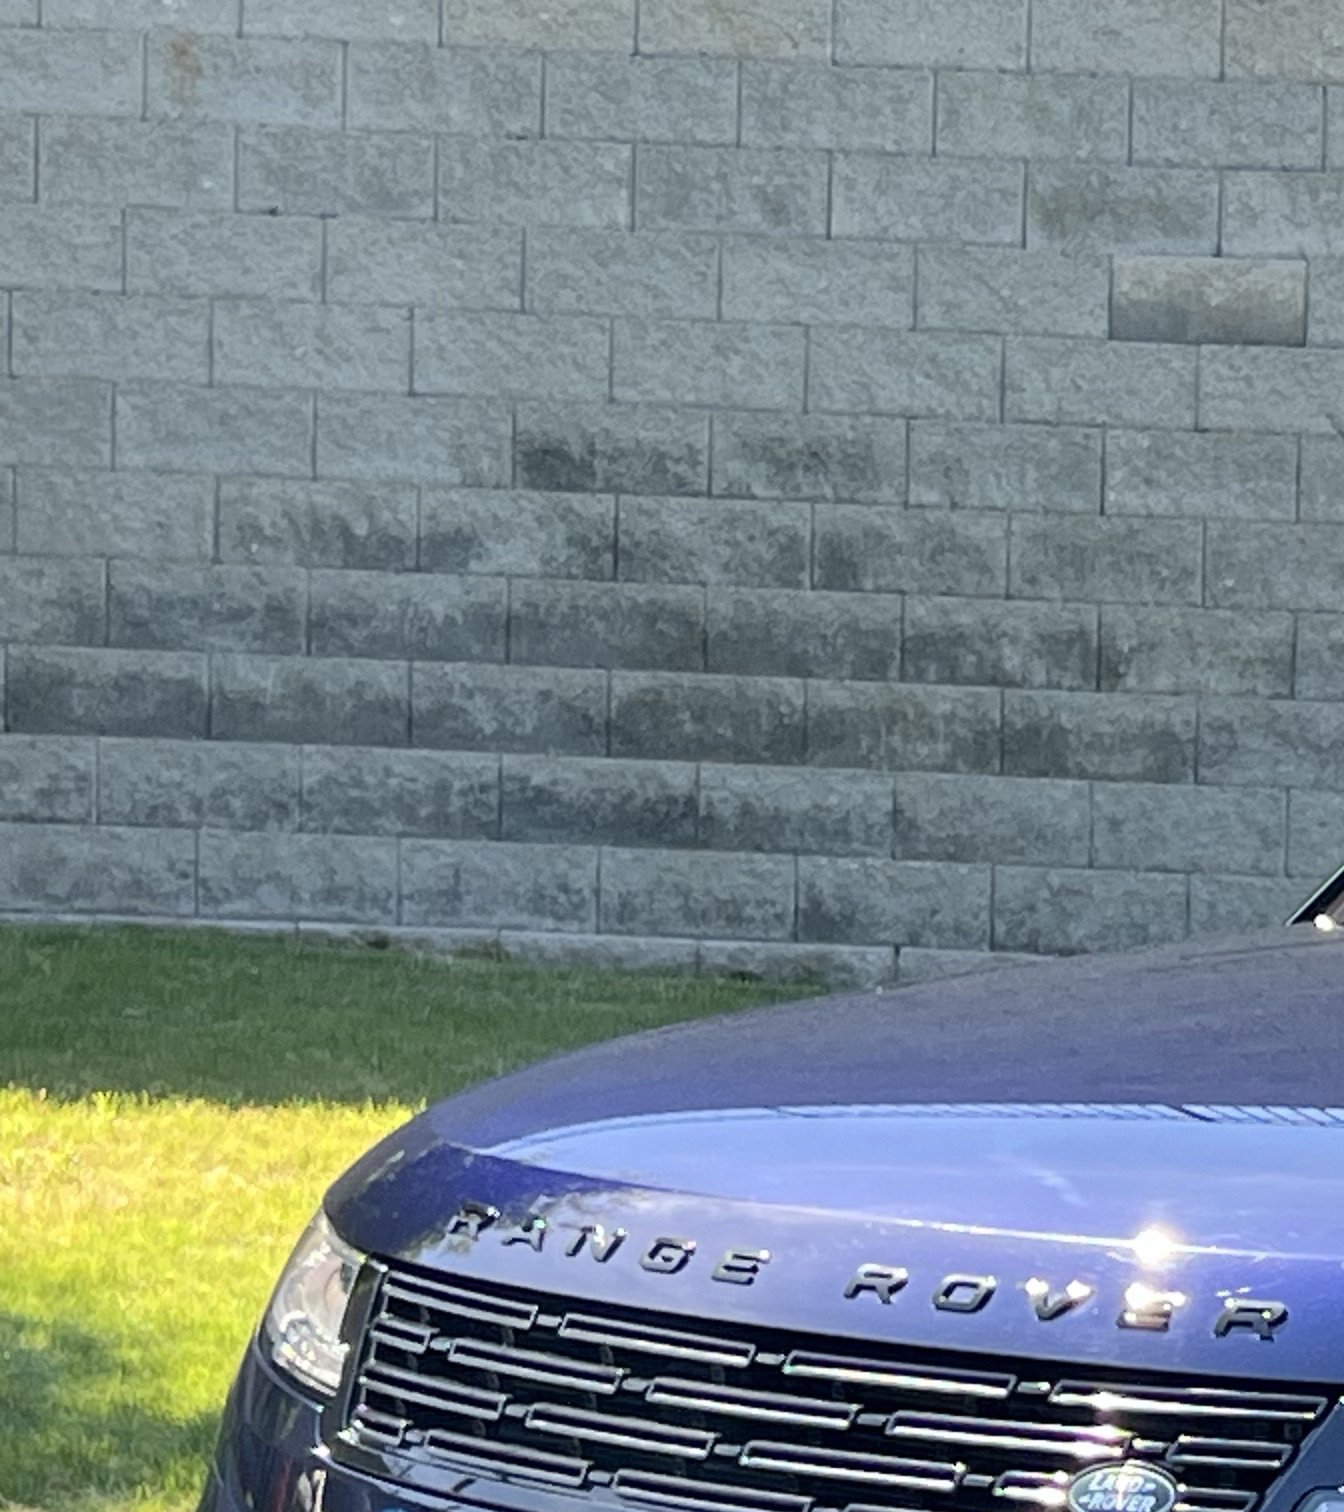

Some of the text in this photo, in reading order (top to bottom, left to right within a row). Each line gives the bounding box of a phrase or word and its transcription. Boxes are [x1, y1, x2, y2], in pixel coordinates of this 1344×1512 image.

[444, 1203, 1290, 1342] RANGE ROVER
[1087, 1491, 1157, 1512] ROVER
